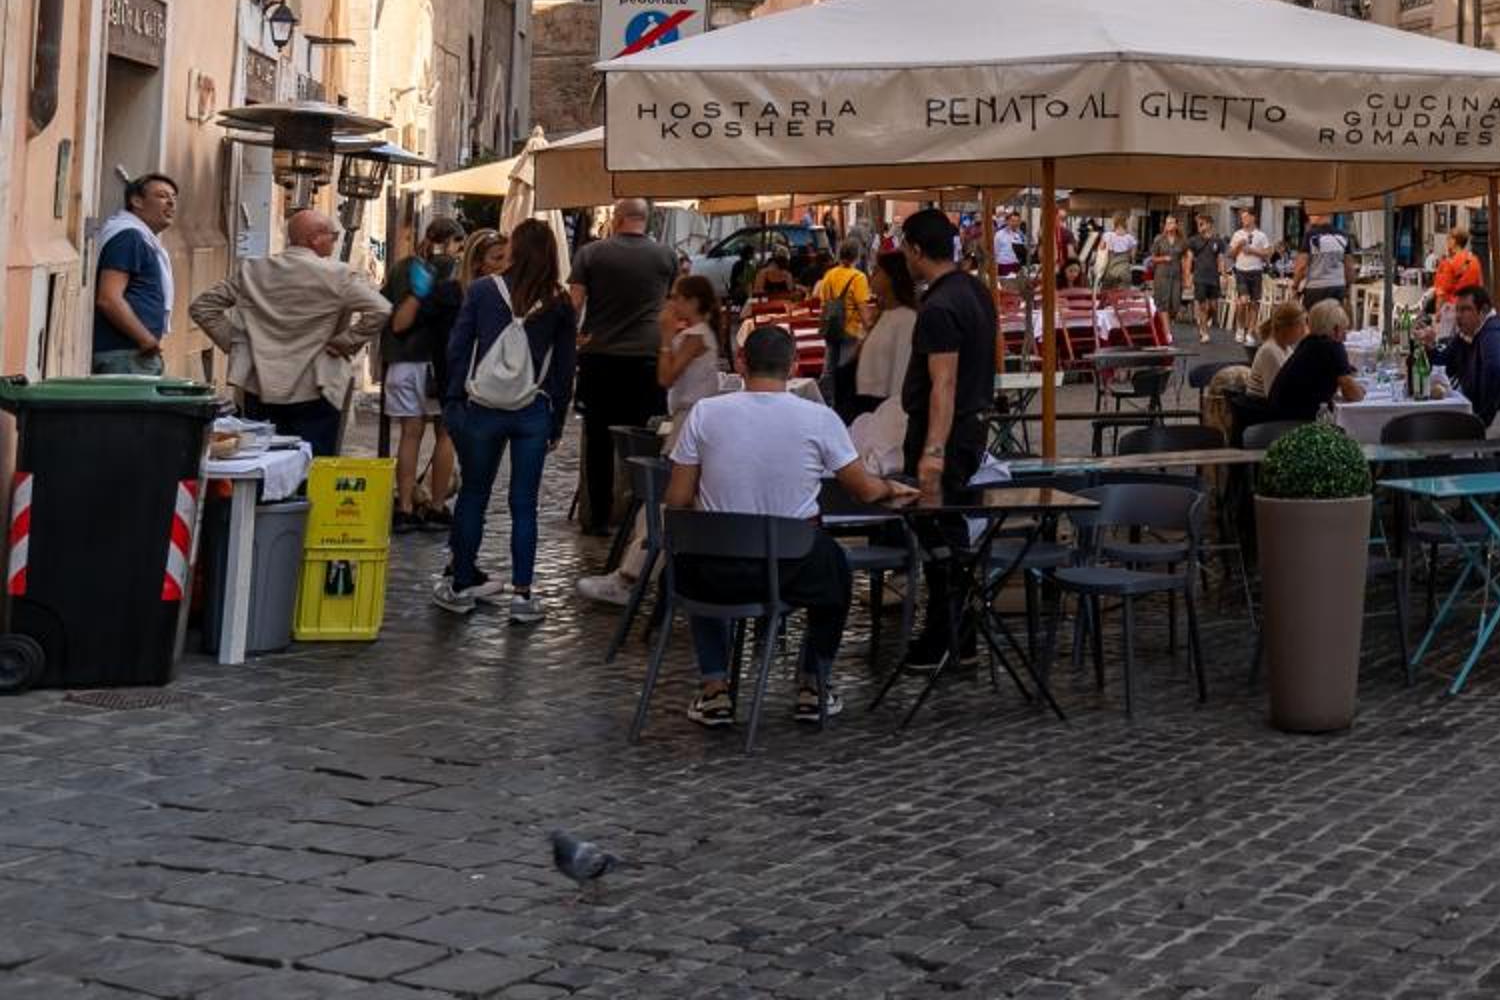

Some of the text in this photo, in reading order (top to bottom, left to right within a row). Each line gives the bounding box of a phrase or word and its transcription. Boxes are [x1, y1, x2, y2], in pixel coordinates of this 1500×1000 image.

[637, 99, 857, 120] HOSTARIA
[925, 91, 1287, 132] RENATO AL GHETTO
[660, 119, 836, 140] KOSHER
